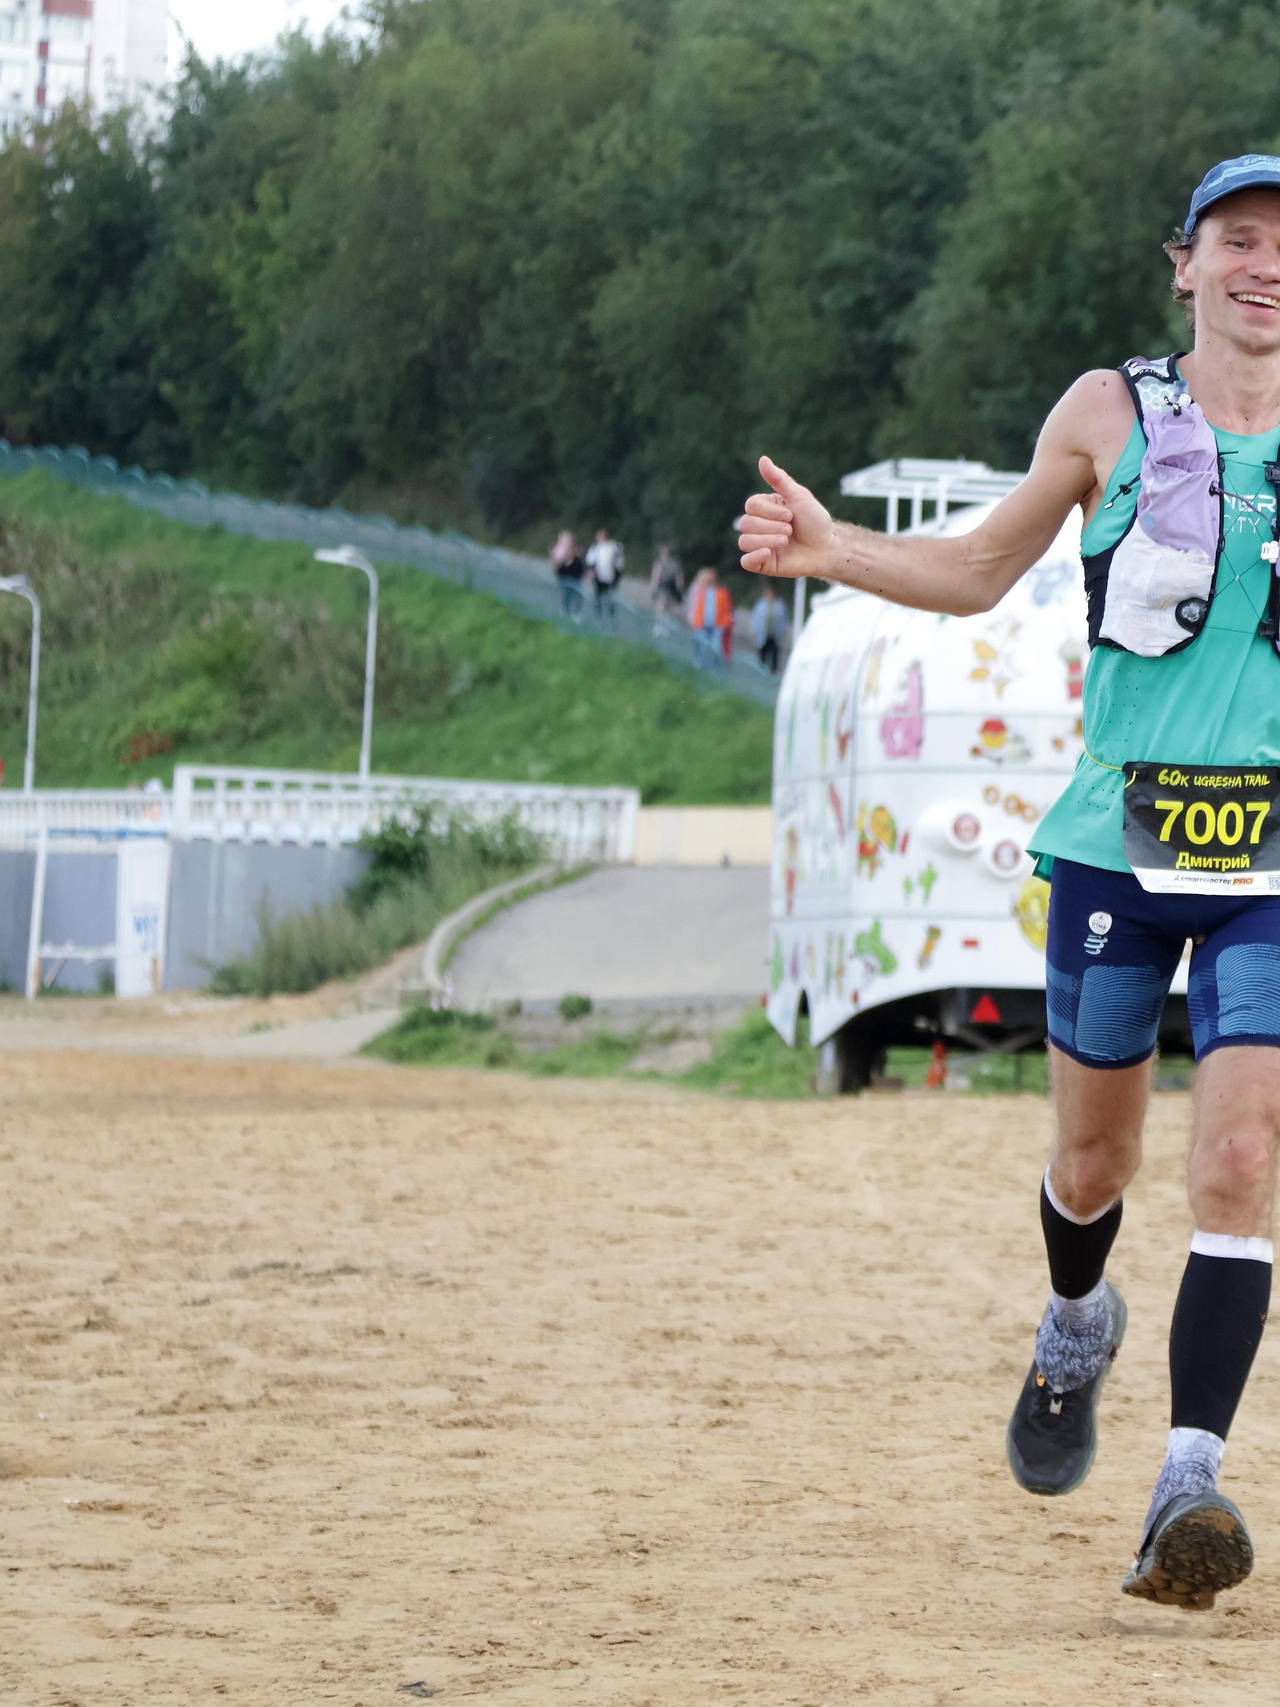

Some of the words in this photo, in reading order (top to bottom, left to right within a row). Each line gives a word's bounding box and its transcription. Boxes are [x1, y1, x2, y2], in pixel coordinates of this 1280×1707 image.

[1224, 493, 1277, 512] NER
[1158, 769, 1189, 787] 60K
[1194, 776, 1242, 788] UGRESHA
[1243, 774, 1270, 787] TRAIL
[1155, 800, 1270, 846] 7007
[1175, 852, 1251, 873] Дмитрий
[1233, 878, 1254, 886] PRO
